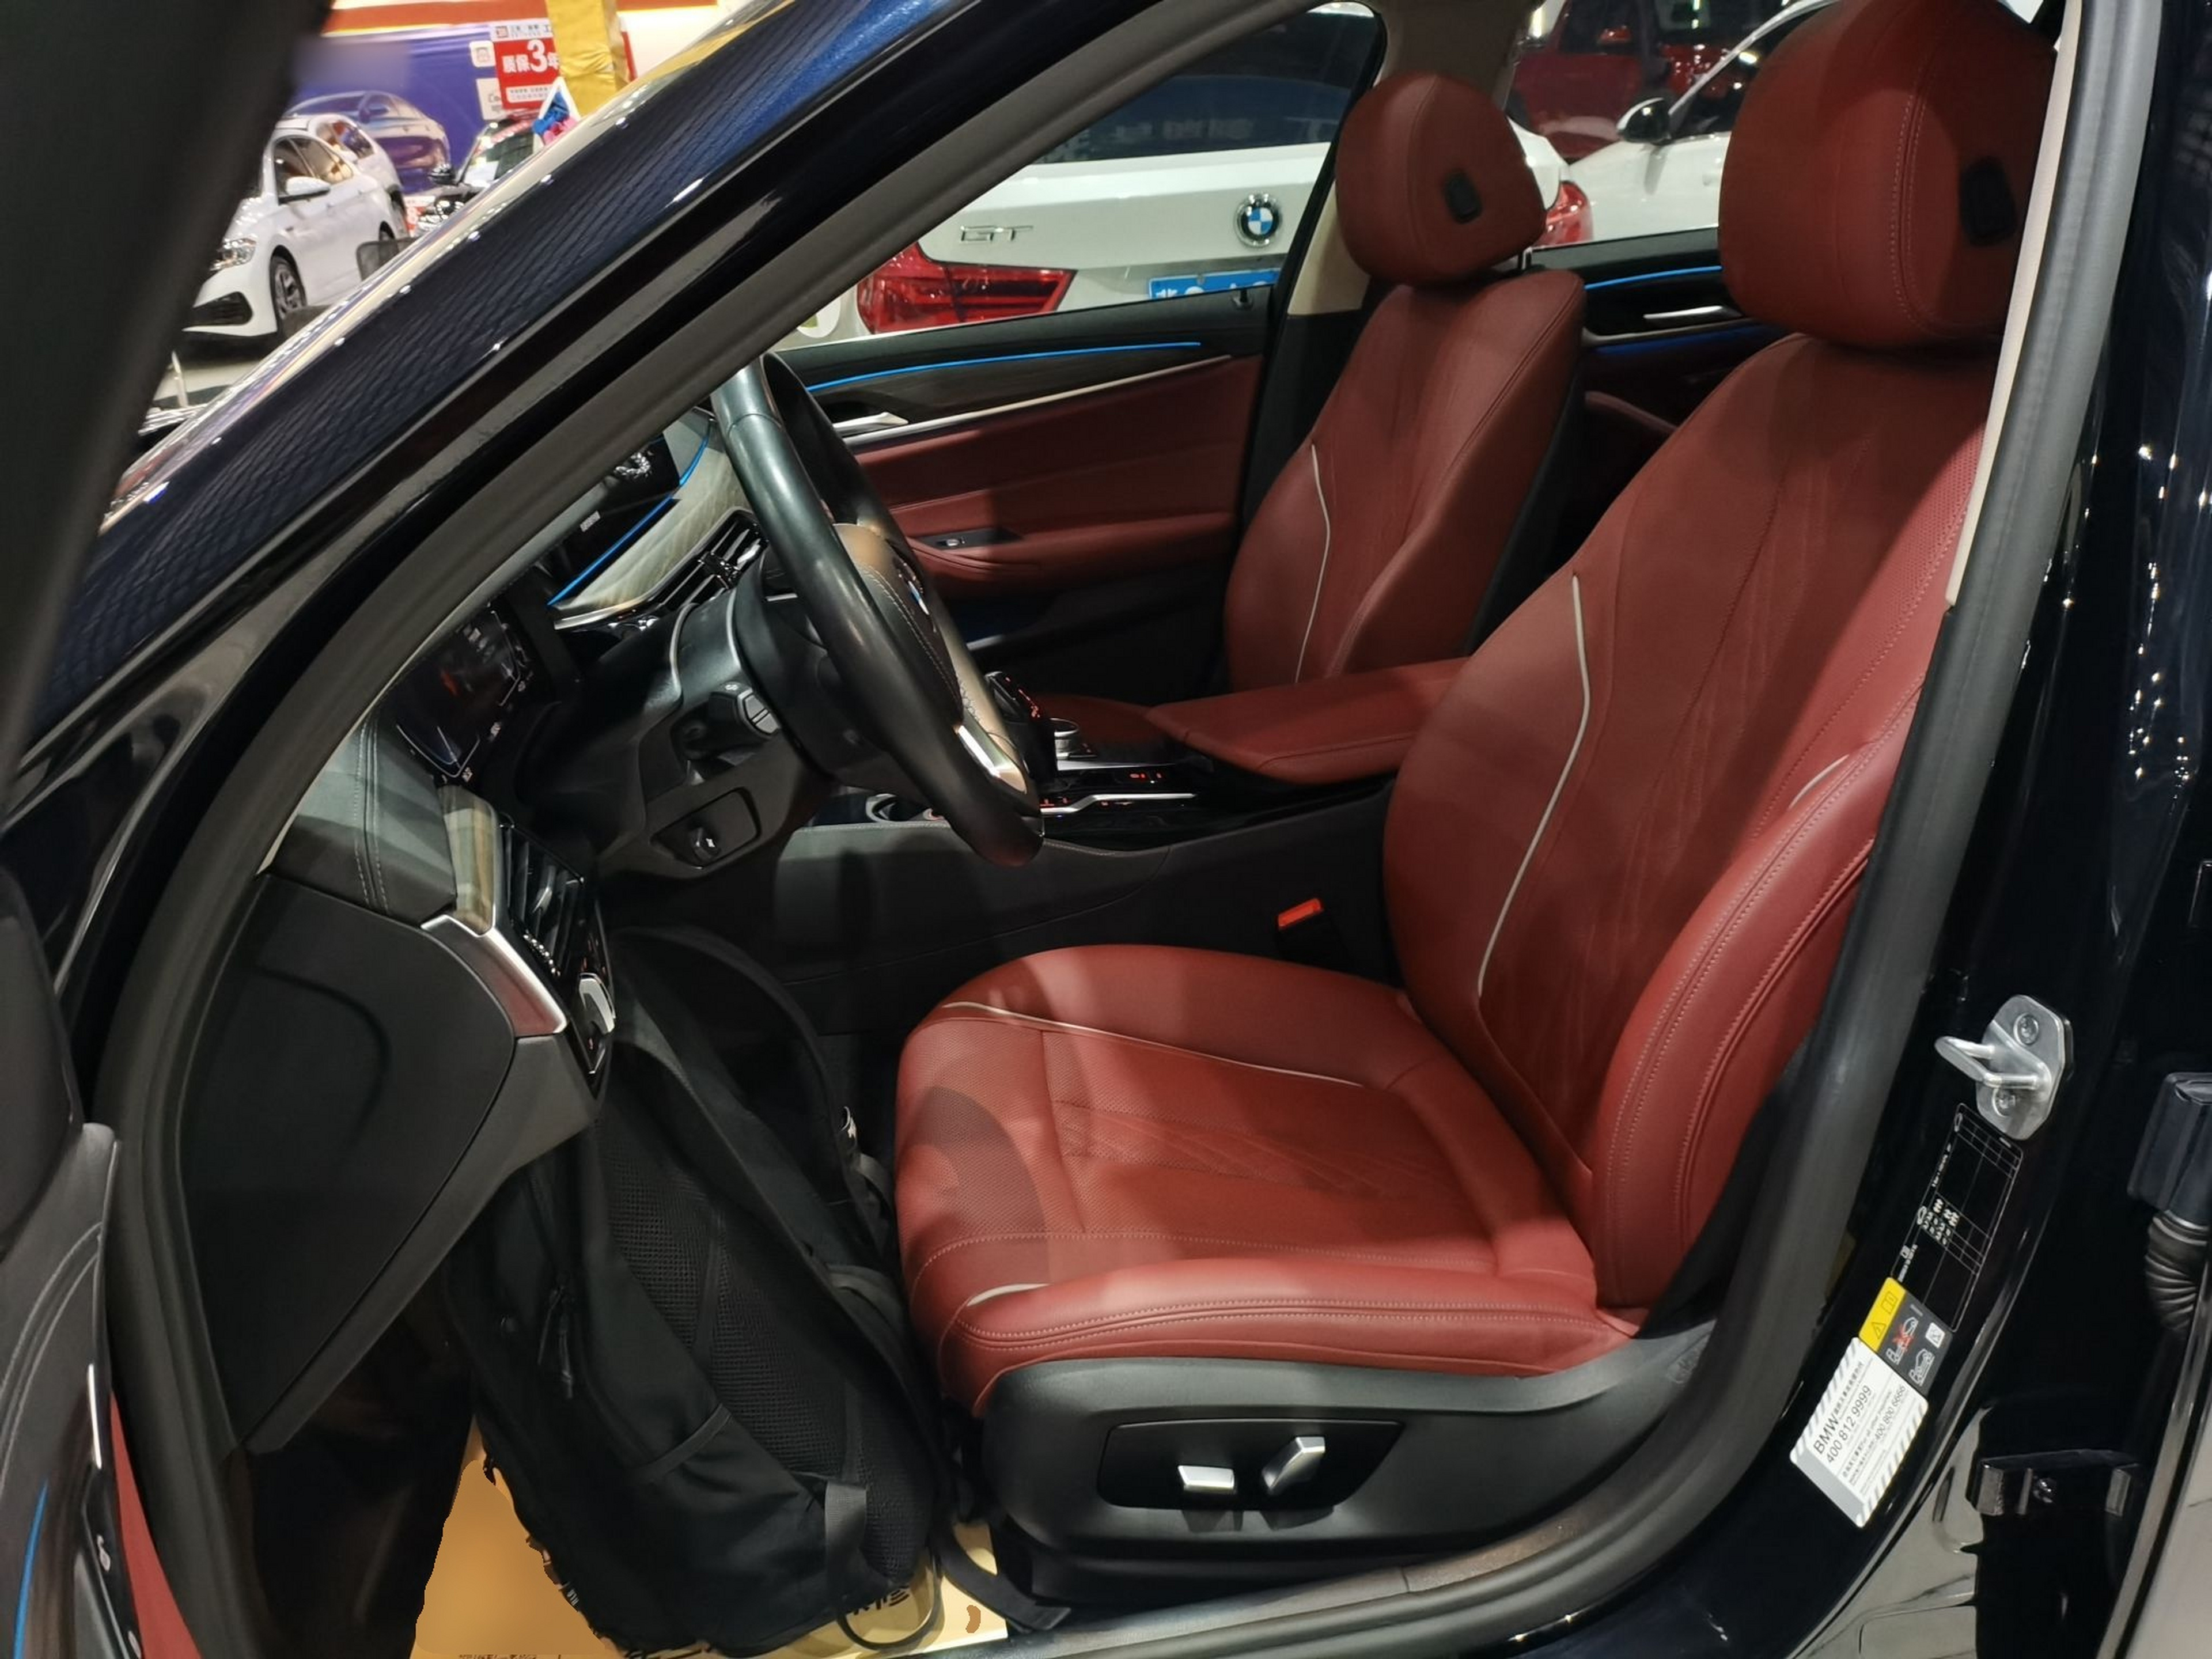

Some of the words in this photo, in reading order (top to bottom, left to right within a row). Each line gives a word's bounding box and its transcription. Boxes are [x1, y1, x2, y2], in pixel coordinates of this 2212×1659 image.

[961, 226, 1033, 241] GT
[1813, 1414, 1839, 1454] BMW
[1827, 1440, 1842, 1462] 400
[1839, 1417, 1855, 1440] 812
[1852, 1385, 1870, 1415] 9999
[1875, 1423, 1885, 1440] 400
